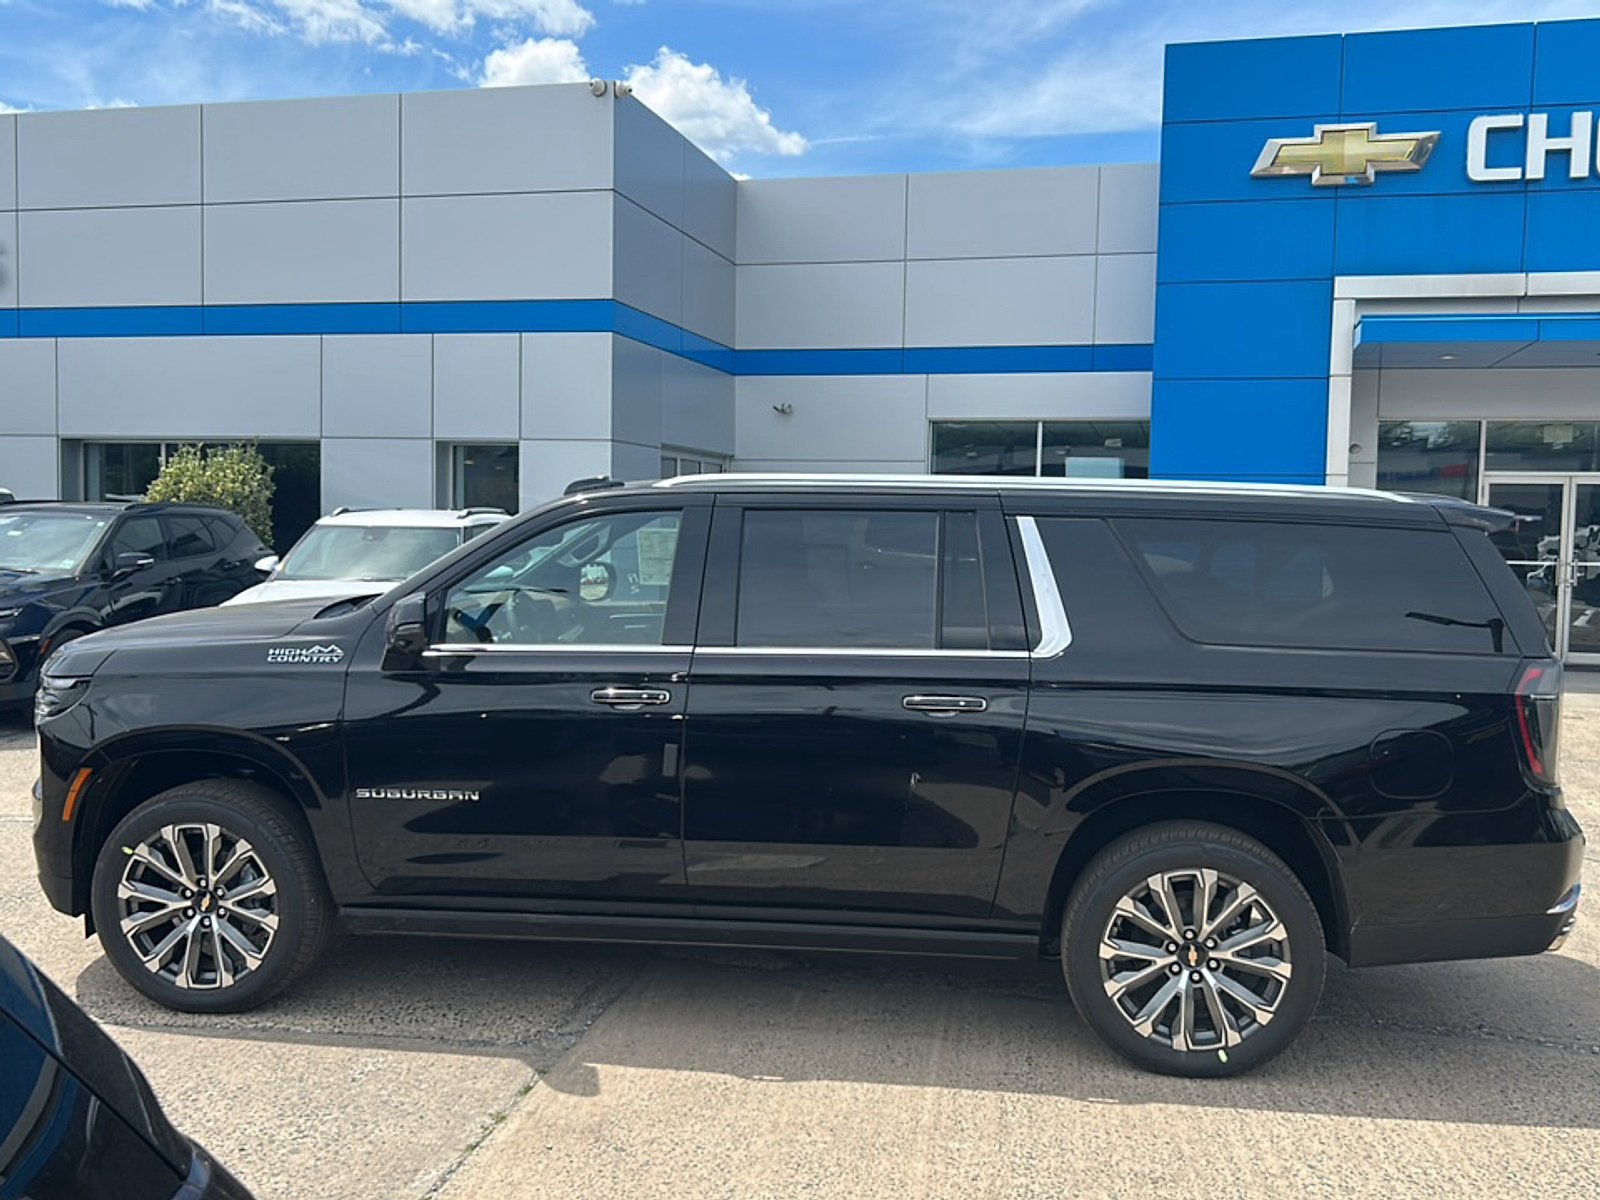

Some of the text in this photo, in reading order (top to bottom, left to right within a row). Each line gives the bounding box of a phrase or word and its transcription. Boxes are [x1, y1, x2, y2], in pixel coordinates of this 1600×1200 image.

[1466, 111, 1600, 181] CH
[268, 647, 307, 655] HIGH
[267, 654, 342, 663] COUNTRY
[356, 788, 480, 801] SUBURBAN
